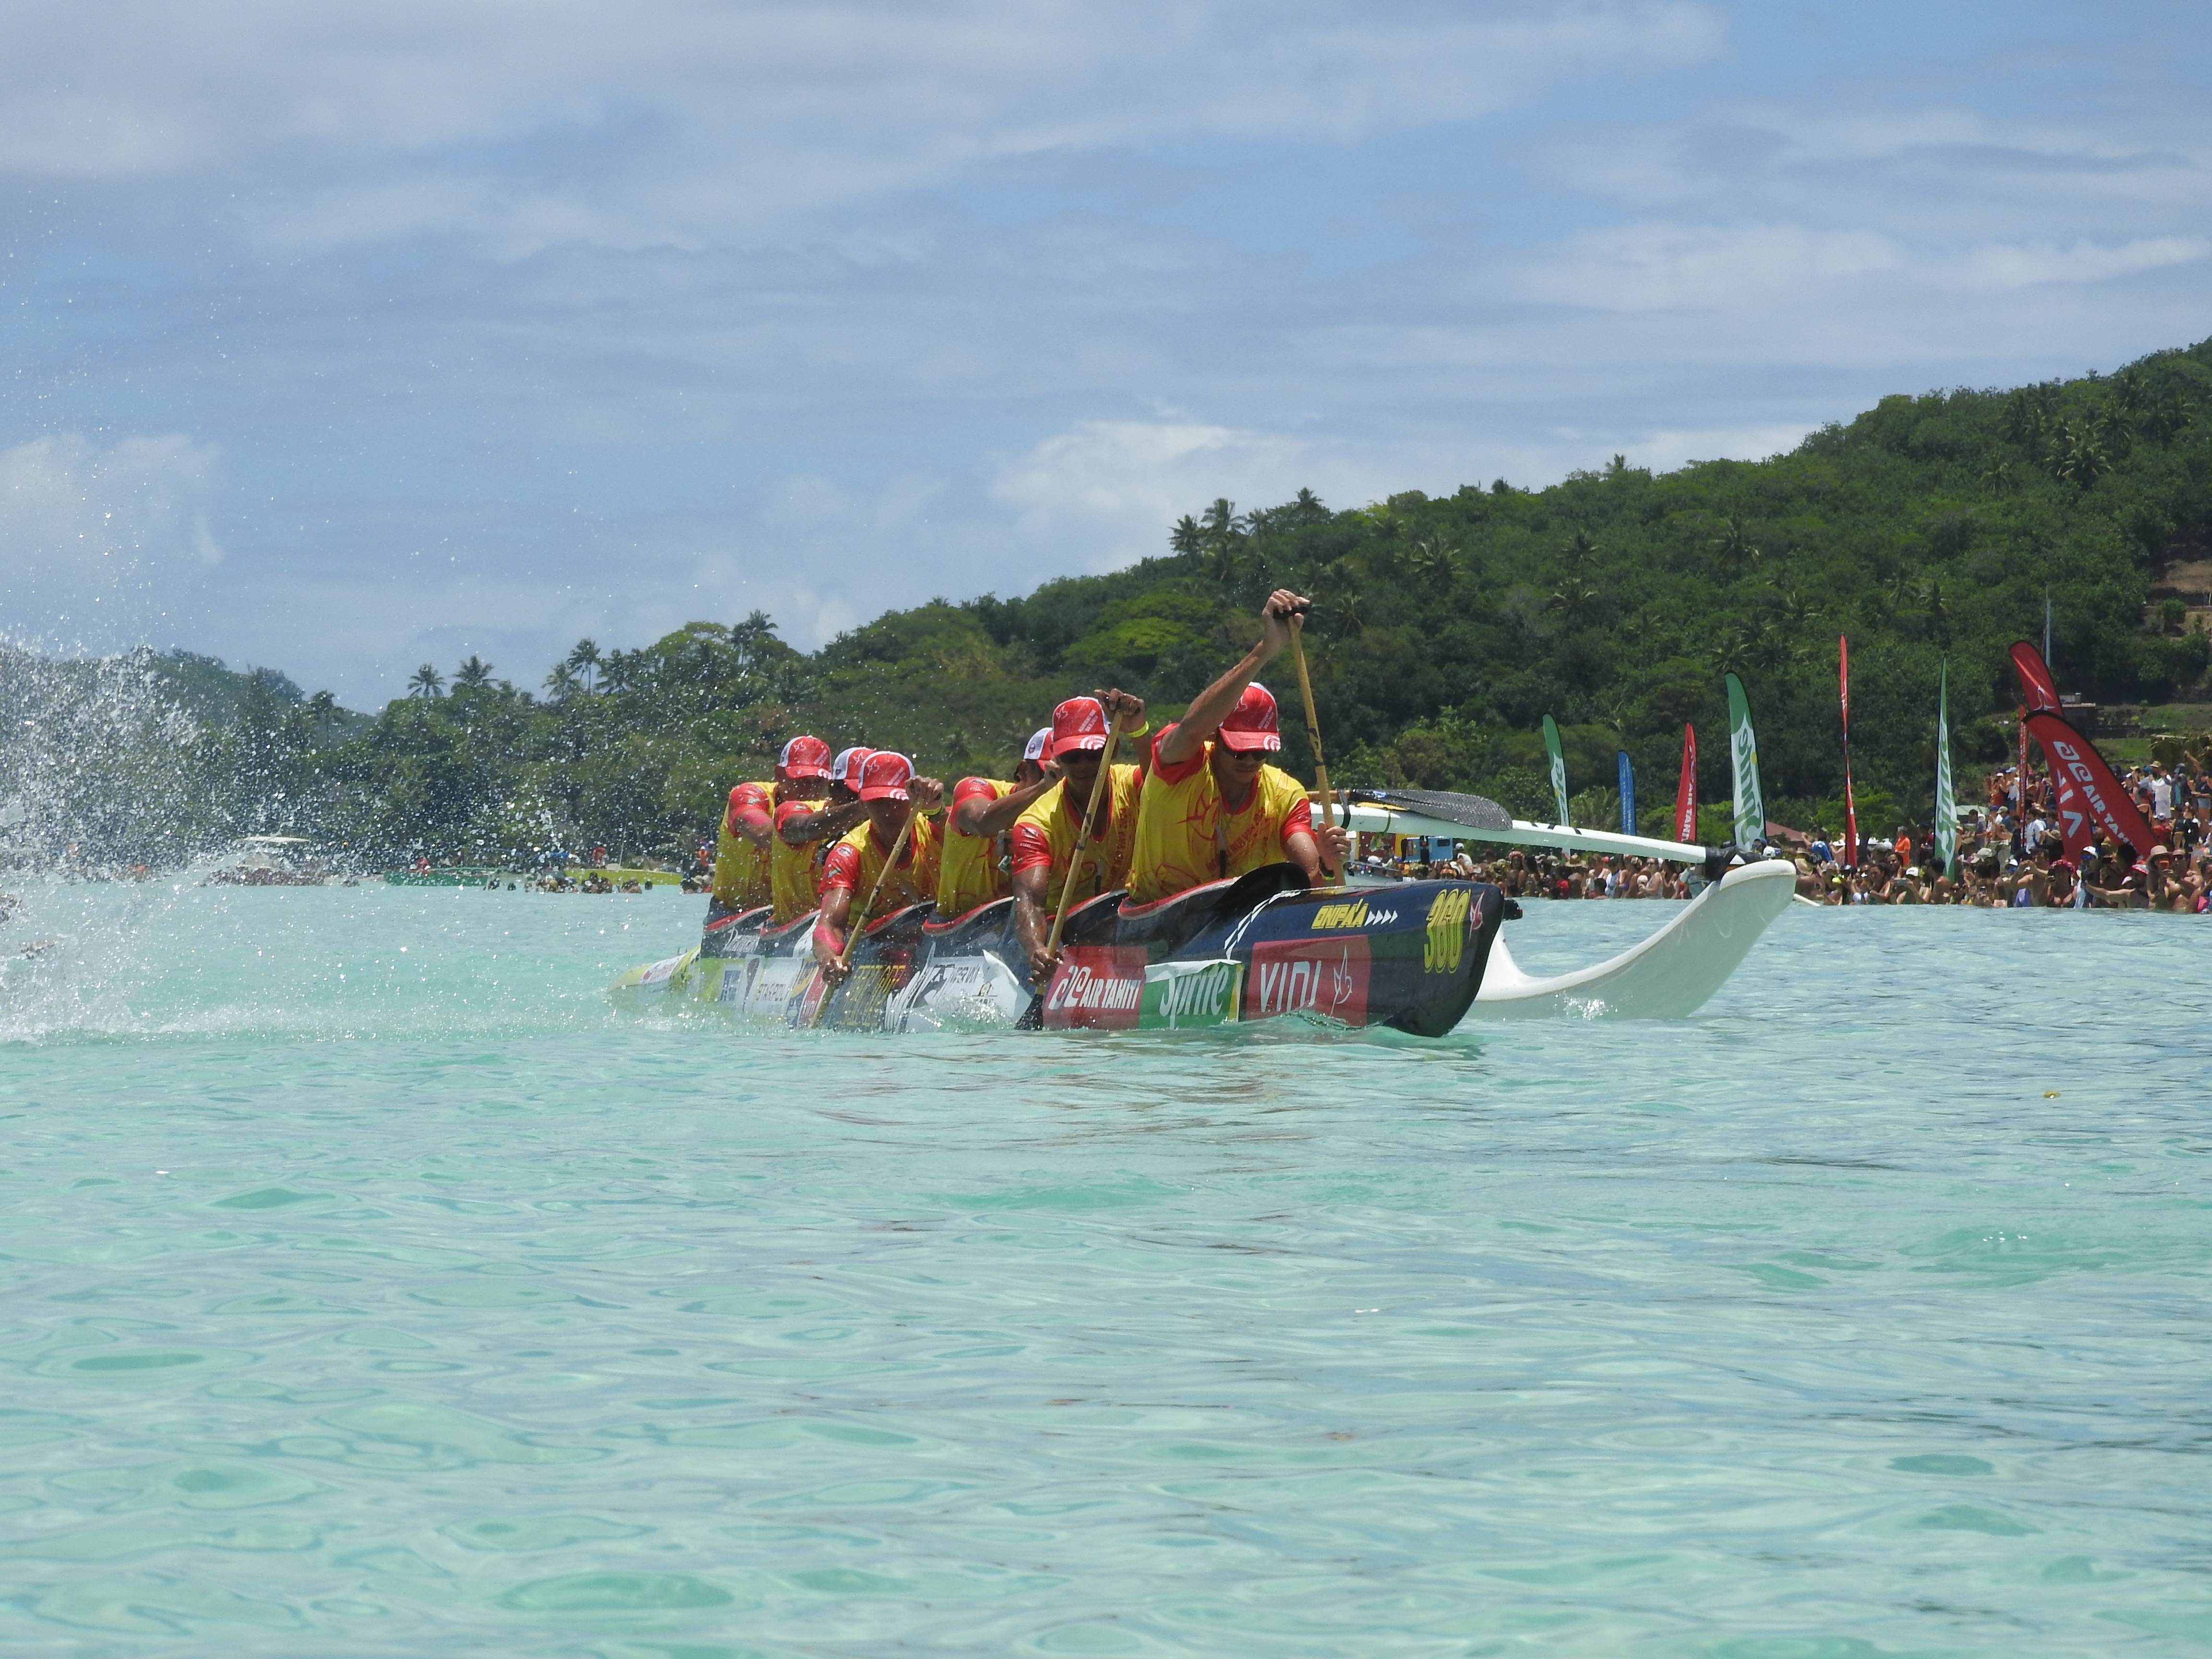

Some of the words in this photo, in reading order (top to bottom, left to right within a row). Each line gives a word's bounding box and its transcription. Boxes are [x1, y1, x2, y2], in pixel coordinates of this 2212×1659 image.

[2082, 784, 2105, 814] AIR
[1681, 808, 1693, 842] TAHI
[1424, 888, 1471, 974] 360
[1079, 978, 1104, 1008] AIR
[1101, 979, 1142, 1009] TAHITI
[1159, 963, 1229, 1029] Sprite
[1260, 960, 1322, 1012] VINI
